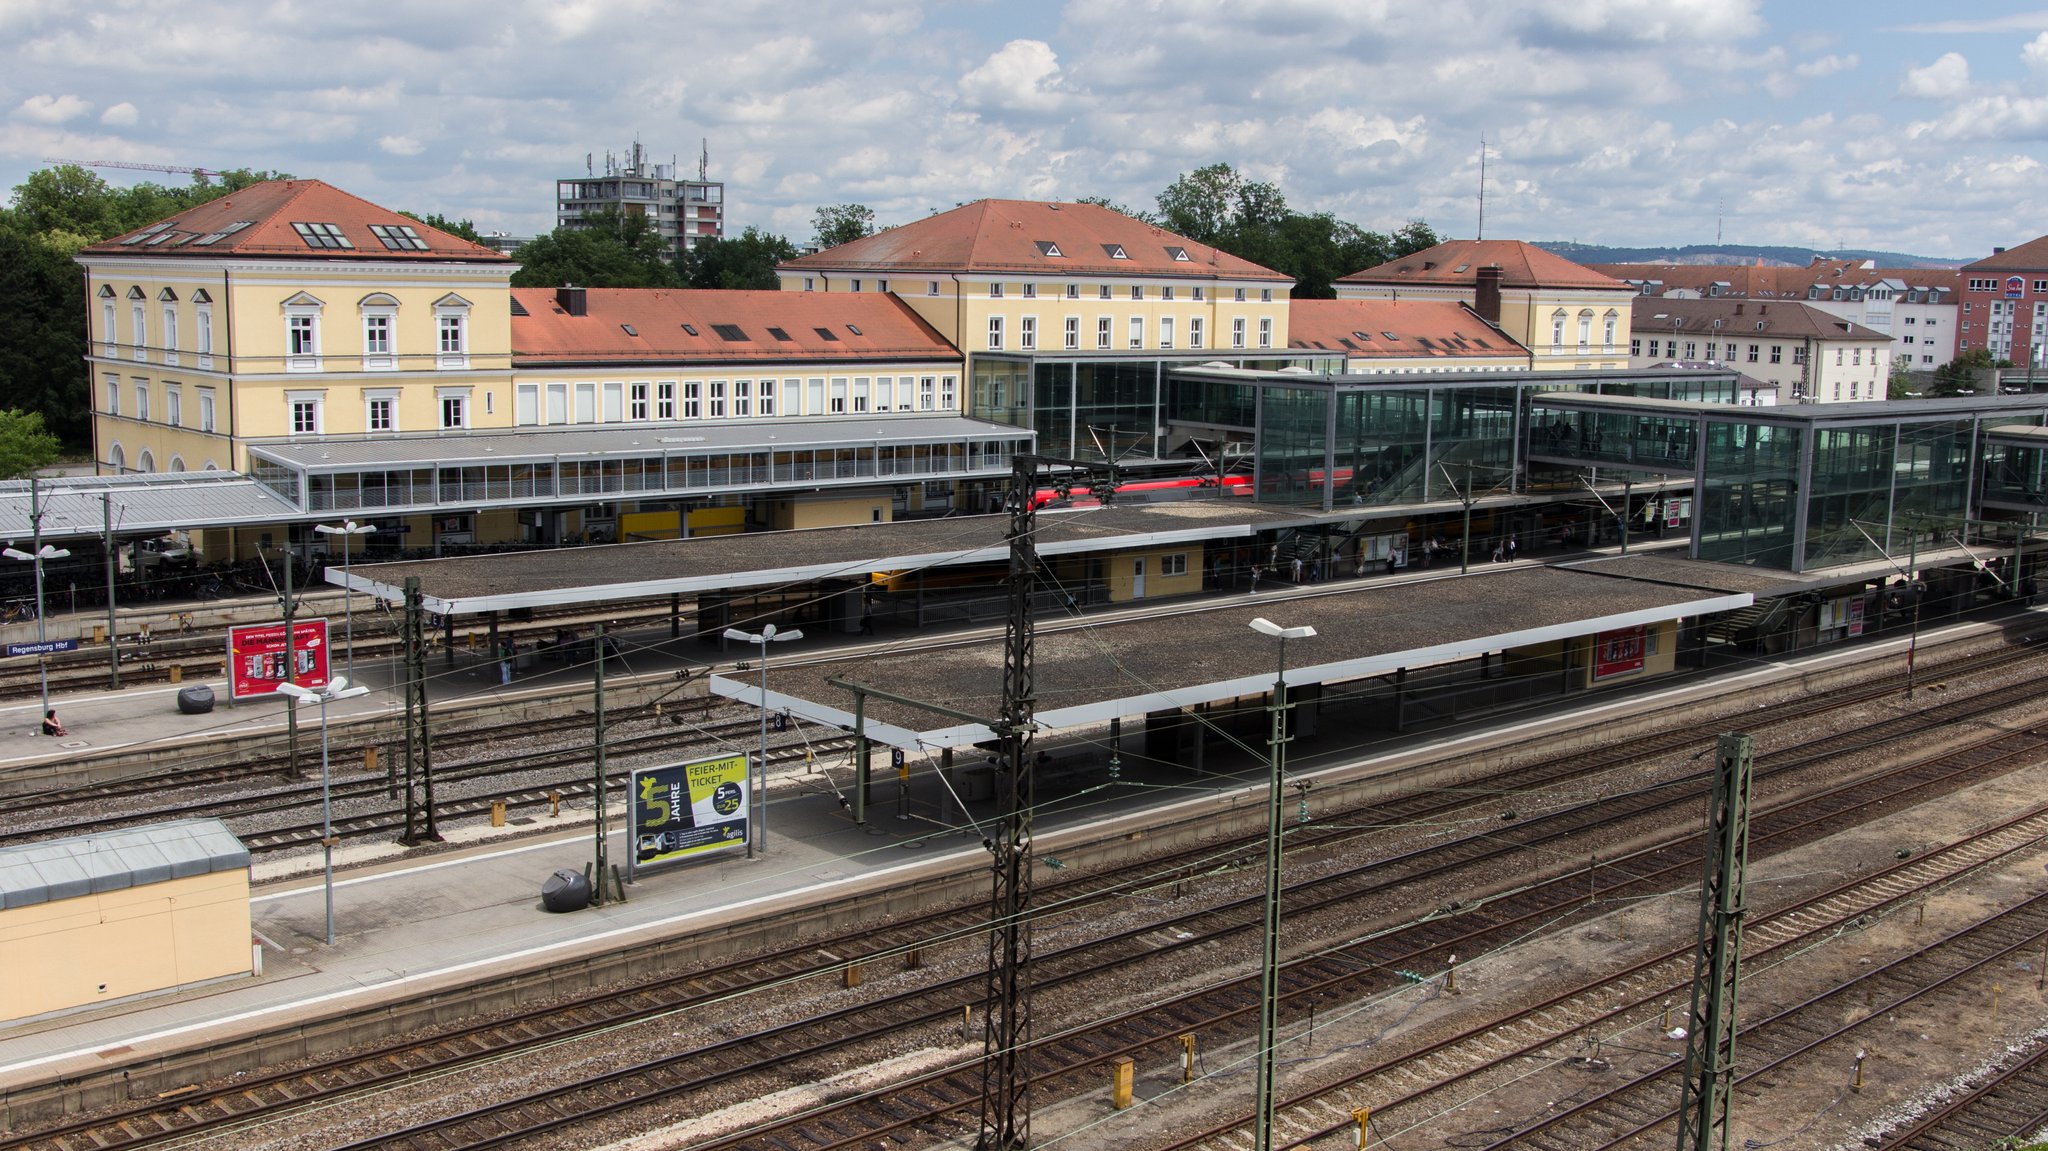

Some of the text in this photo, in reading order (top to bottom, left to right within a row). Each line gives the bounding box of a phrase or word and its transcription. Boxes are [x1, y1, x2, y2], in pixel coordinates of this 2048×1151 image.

[256, 634, 309, 644] MANNSAFT
[12, 644, 54, 654] Regensburg
[776, 714, 782, 728] 8
[895, 751, 902, 765] 9
[689, 761, 738, 776] FEIER-MIT-
[691, 774, 723, 788] TICKET
[718, 787, 725, 799] 5
[644, 783, 670, 827] 5
[670, 782, 681, 822] JAHRE
[725, 799, 739, 811] 25
[726, 829, 743, 839] agilis
